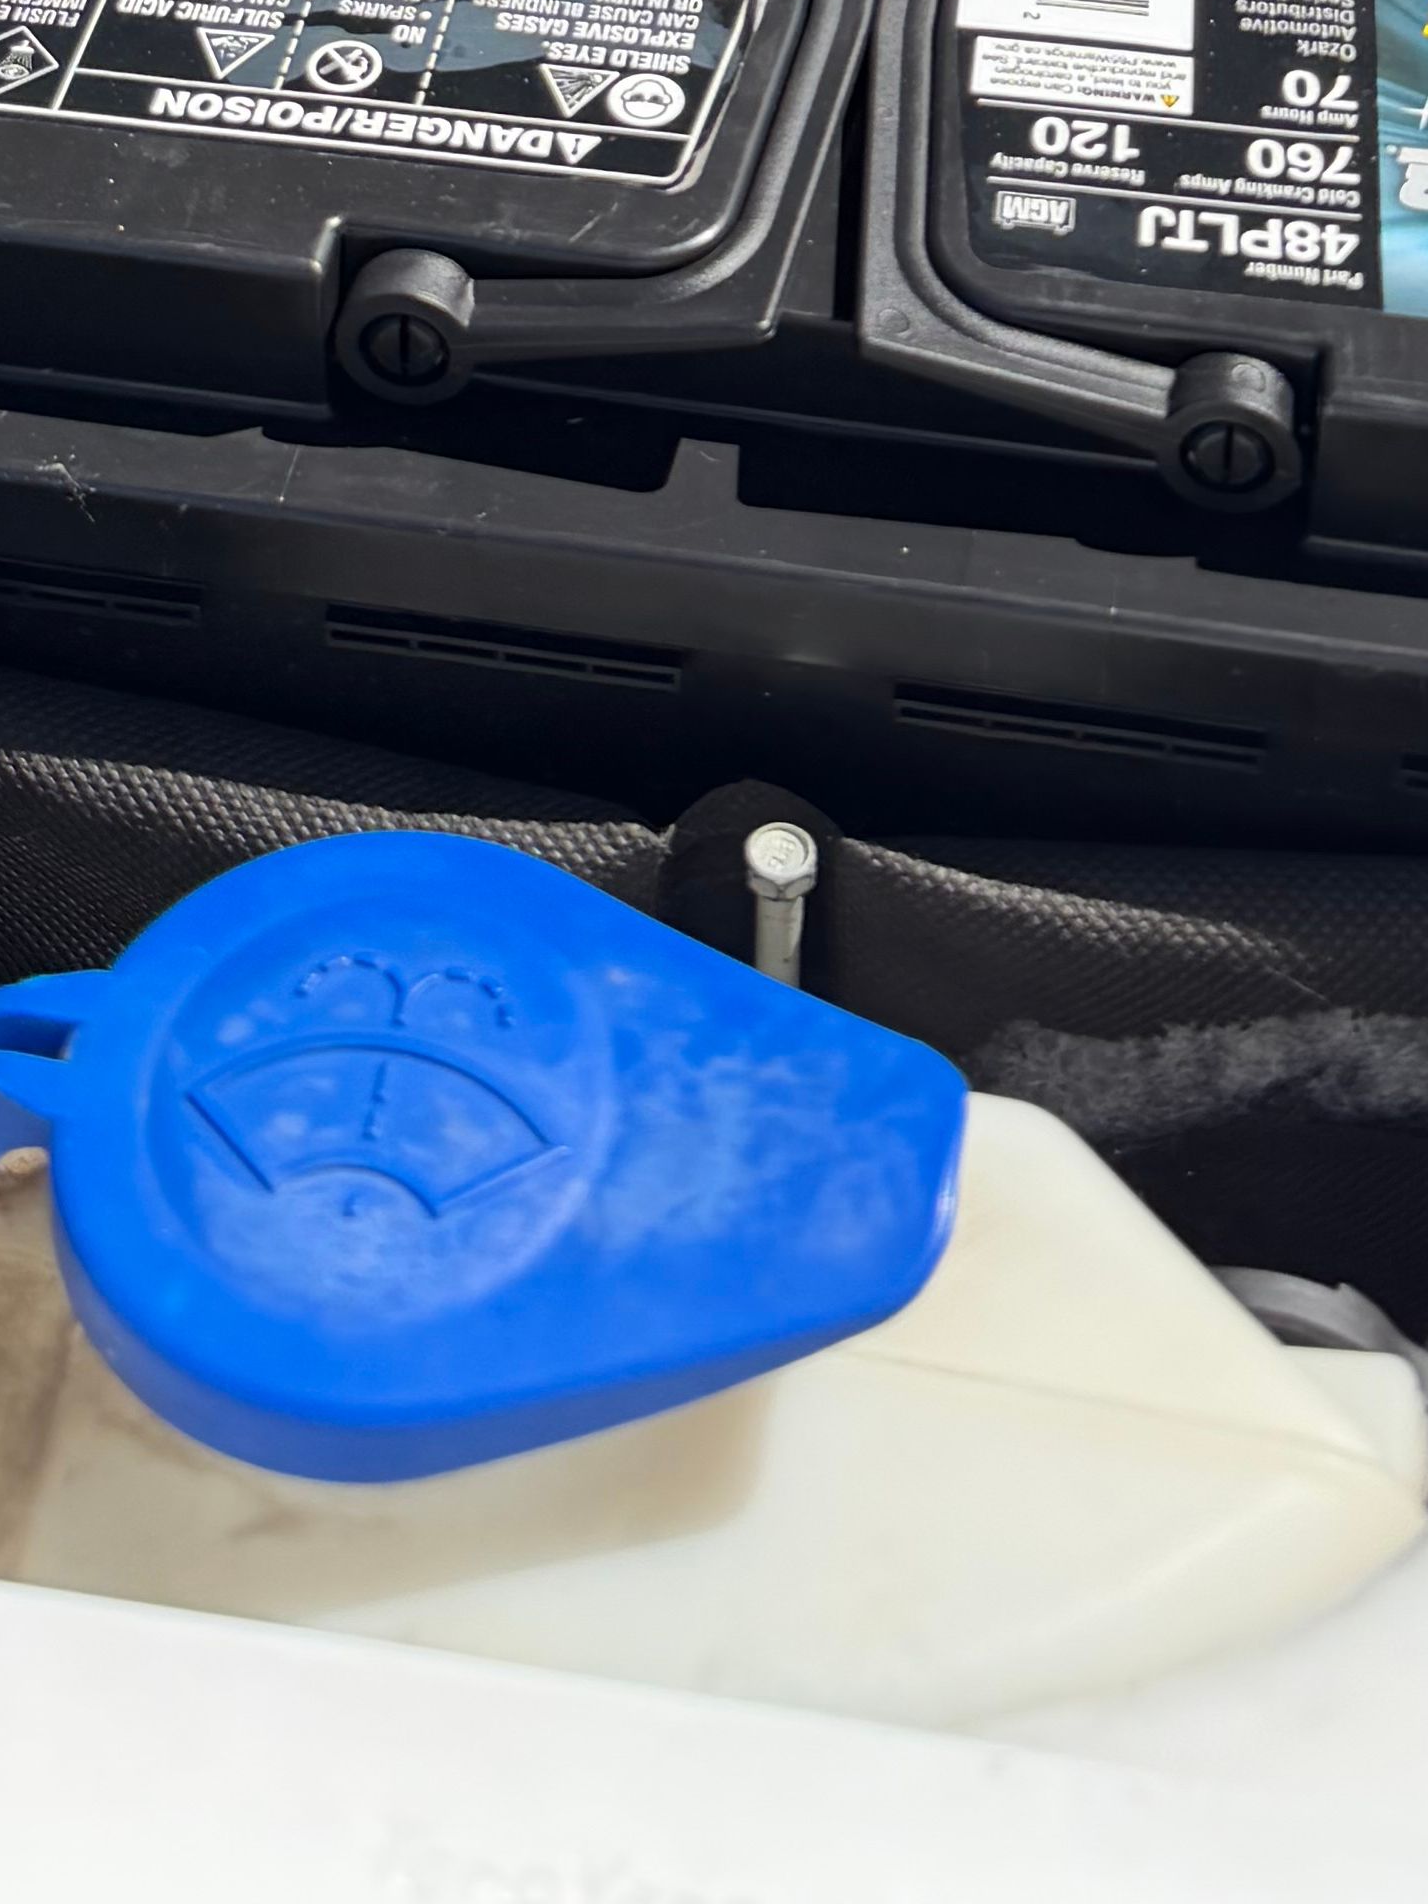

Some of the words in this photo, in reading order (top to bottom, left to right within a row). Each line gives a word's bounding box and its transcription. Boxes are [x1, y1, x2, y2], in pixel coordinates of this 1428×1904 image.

[12, 4, 81, 28] FLUSH
[176, 0, 285, 28] SULFURIC
[337, 0, 417, 20] SPARKS
[587, 3, 654, 24] CAUSE
[657, 12, 700, 29] CAN
[1022, 11, 1041, 20] 2
[390, 23, 426, 45] NO
[494, 12, 570, 38] GASES
[575, 20, 696, 50] EXPLOSIVE
[1238, 16, 1357, 42] Automotive
[540, 40, 606, 65] EYES.
[608, 47, 691, 74] SHIELD
[1295, 39, 1357, 63] Ozark
[1077, 85, 1156, 103] WARNING:
[1281, 69, 1360, 112] 70
[149, 88, 554, 158] DANGER/POISON
[1259, 105, 1315, 126] Hours
[1316, 109, 1359, 129] Amp
[1030, 116, 1141, 163] 120
[989, 151, 1070, 177] Capacity
[1071, 161, 1146, 186] Reserve
[1245, 137, 1360, 185] 760
[1234, 176, 1315, 205] Cranking
[1315, 188, 1361, 208] Cold
[1000, 193, 1070, 225] AGM
[1136, 204, 1360, 267] 48PLTJ
[1243, 261, 1321, 285] Number
[1322, 268, 1364, 290] Part
